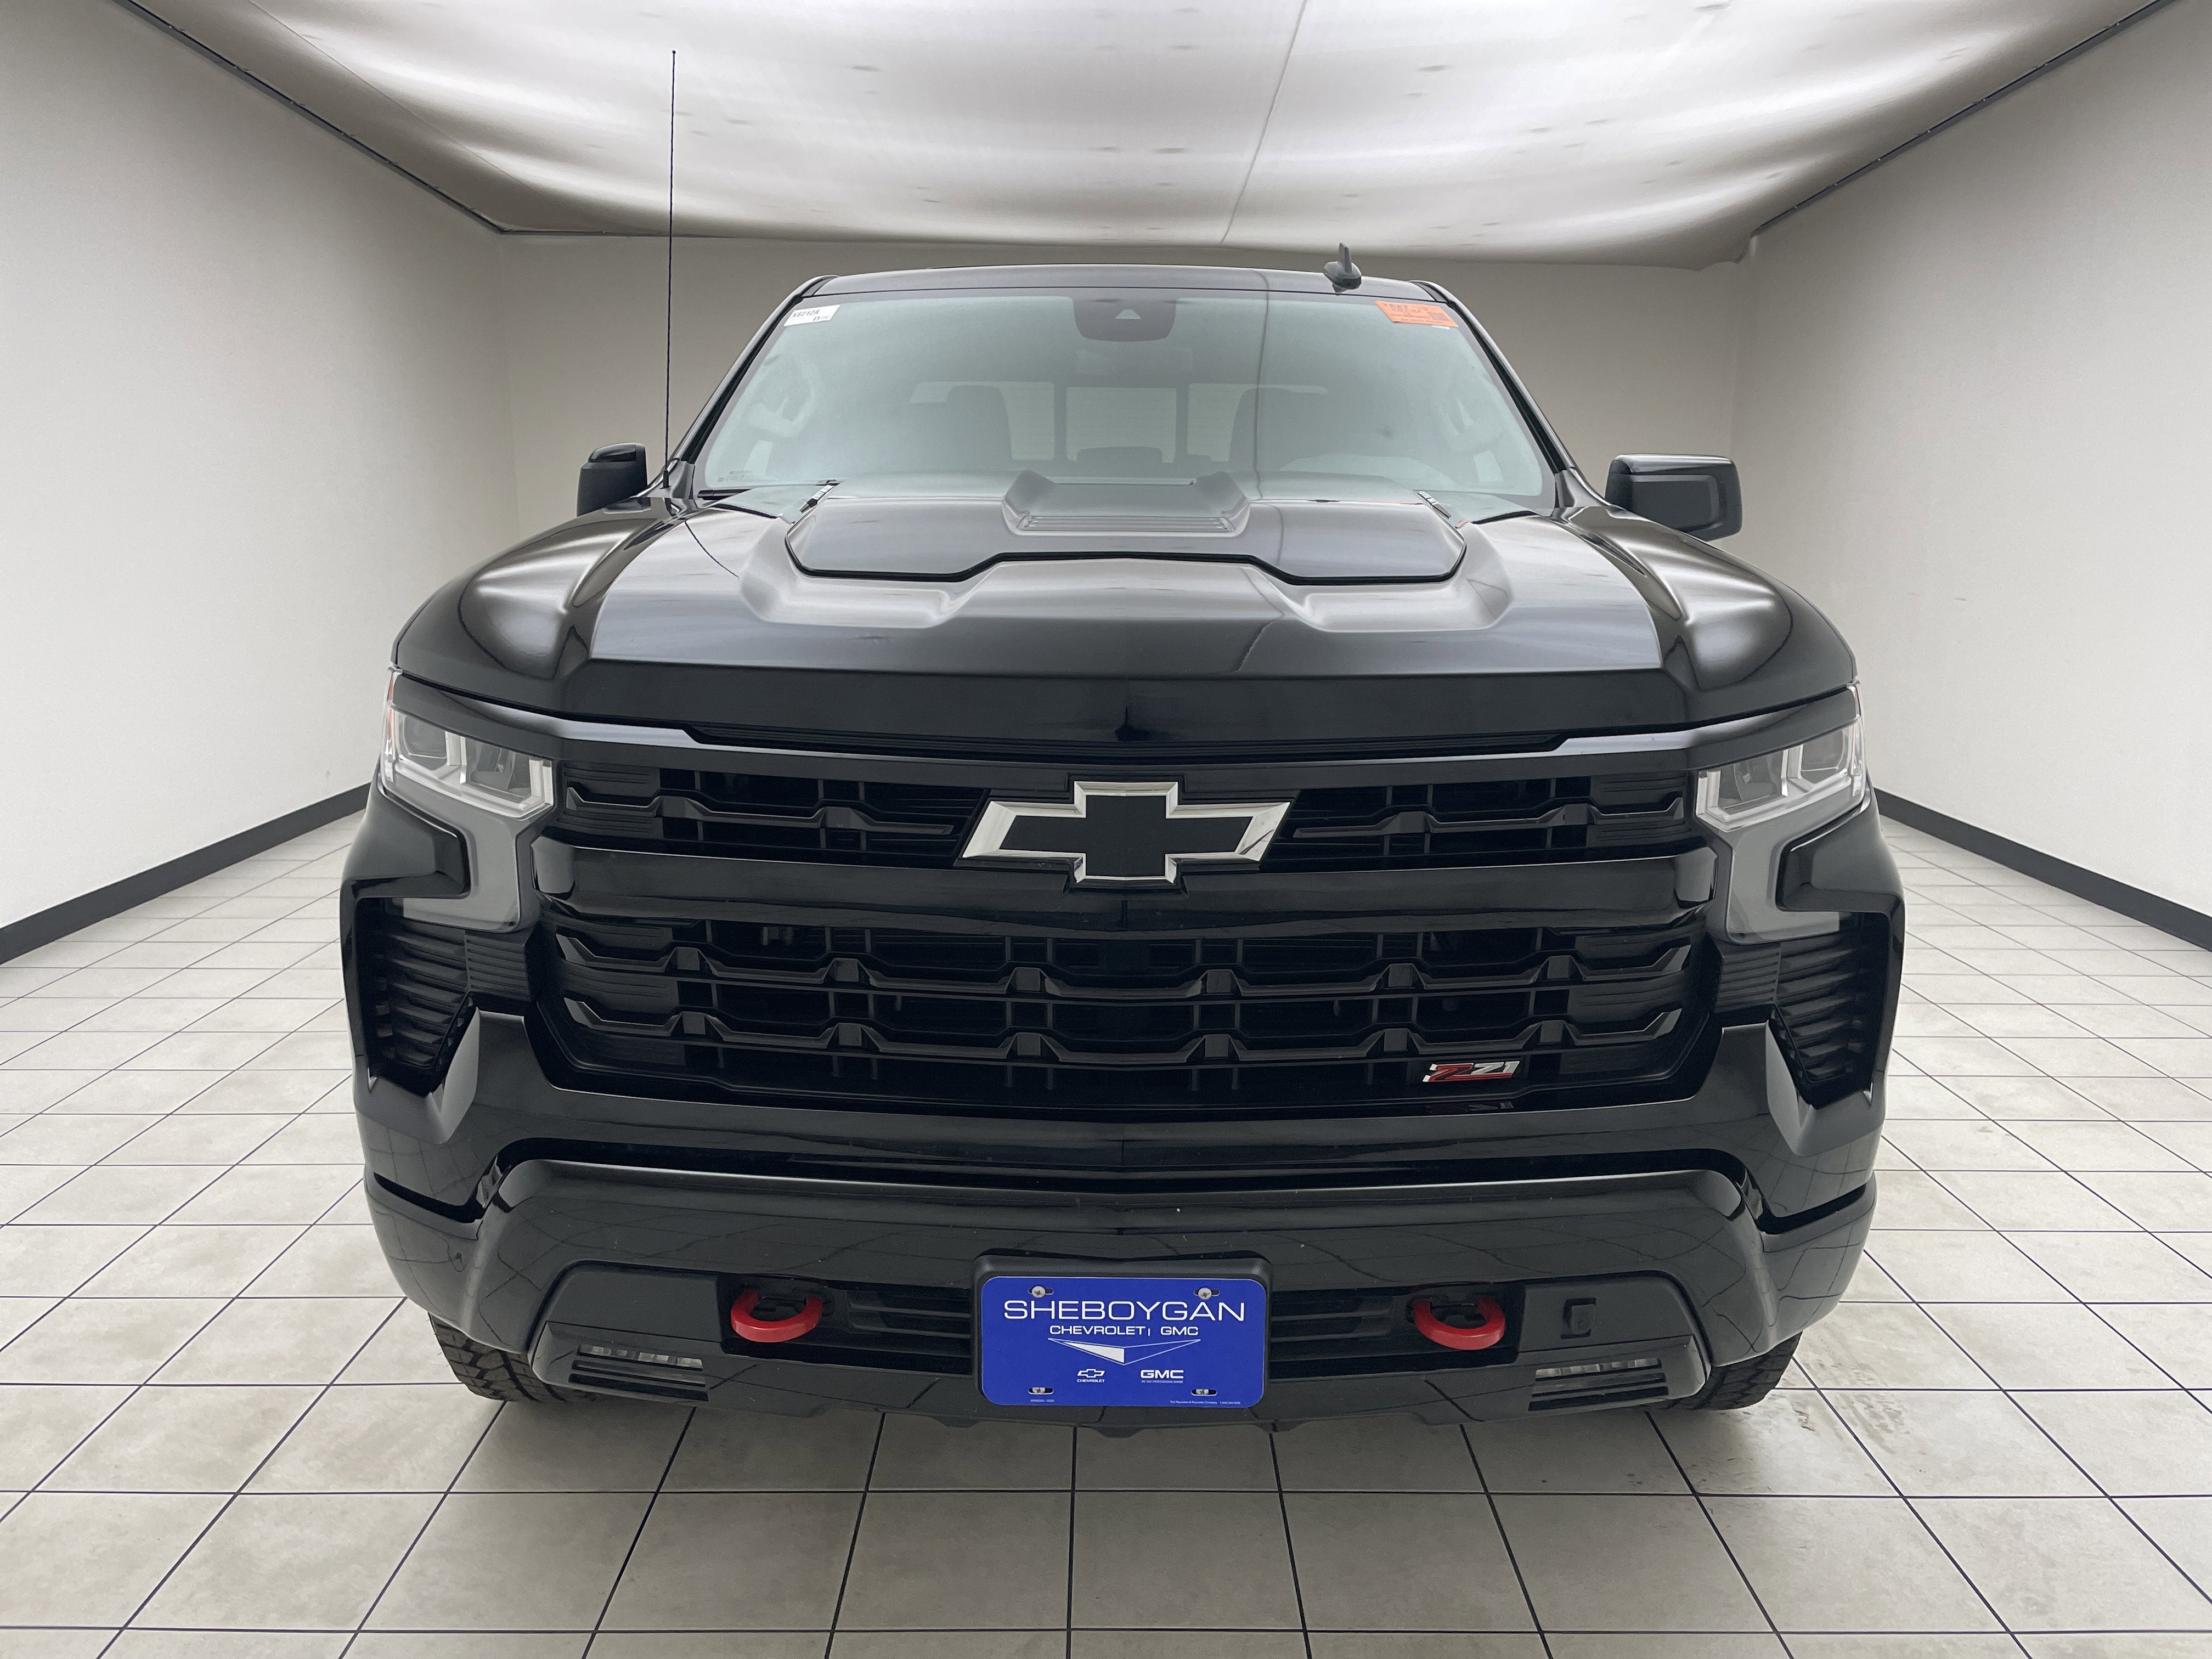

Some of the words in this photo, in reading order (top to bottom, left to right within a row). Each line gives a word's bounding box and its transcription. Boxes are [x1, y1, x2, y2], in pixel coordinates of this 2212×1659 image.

[1003, 1300, 1245, 1322] SHEBOYGAN
[1049, 1325, 1146, 1335] CHEVROLET
[1160, 1326, 1199, 1336] GMC
[1141, 1369, 1184, 1379] GMC
